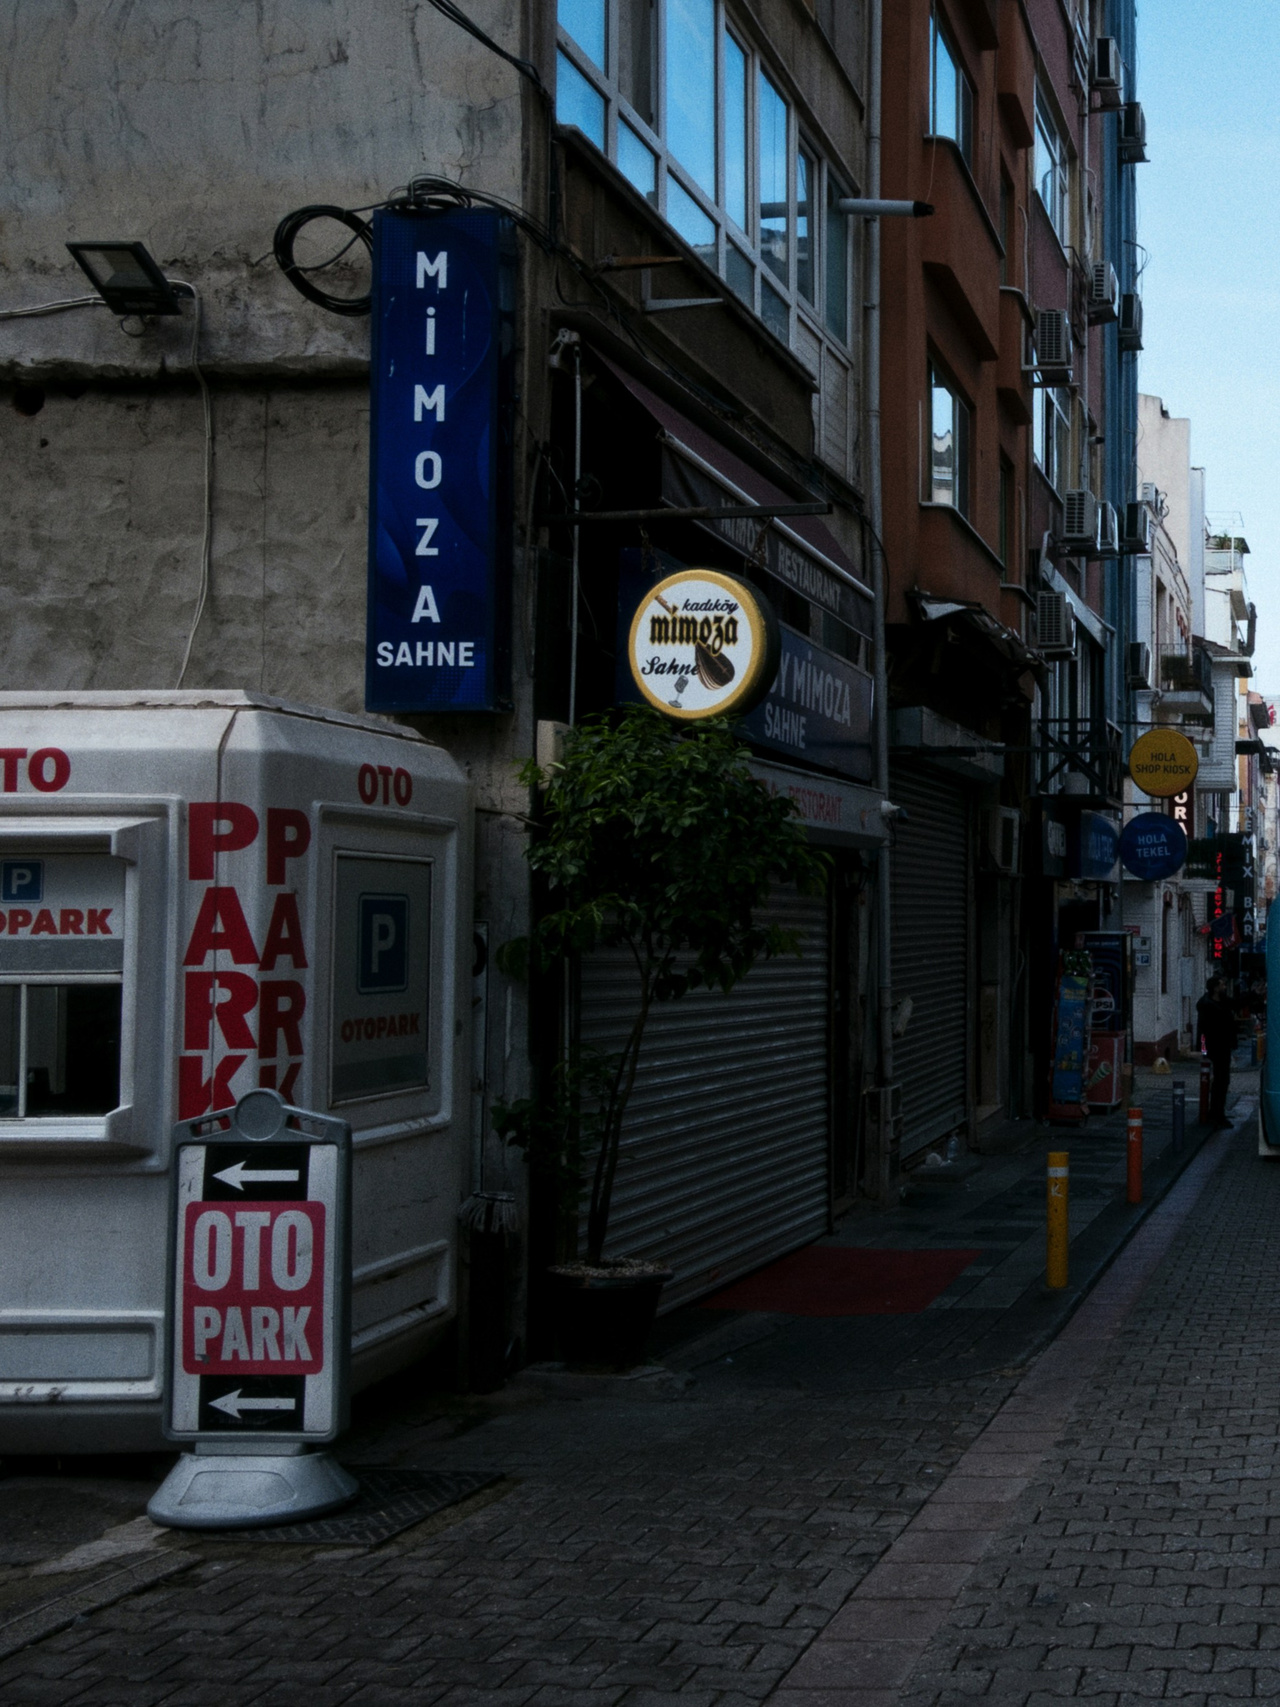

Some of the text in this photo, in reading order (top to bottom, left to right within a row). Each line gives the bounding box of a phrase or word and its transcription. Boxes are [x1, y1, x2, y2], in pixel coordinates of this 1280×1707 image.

[778, 541, 841, 612] RESTAURANT
[650, 615, 738, 656] mimoza
[376, 641, 475, 667] SAHNE
[641, 656, 700, 675] Sahne
[793, 650, 851, 727] MİMOZA
[764, 702, 807, 749] SAHNE
[1135, 764, 1191, 774] SHOP KIOSK
[1150, 752, 1176, 762] HOLA
[358, 763, 413, 806] OTO
[1135, 846, 1171, 858] TEKEL
[1137, 834, 1168, 845] HOLA
[11, 868, 33, 895] P
[0, 908, 113, 935] PARK
[1243, 896, 1254, 936] BAR
[371, 913, 397, 974] P
[178, 802, 260, 1131] PARK
[340, 1012, 421, 1043] OTOPARK
[1129, 1131, 1138, 1141] K
[193, 1210, 314, 1291] OTO
[193, 1306, 313, 1362] PARK
